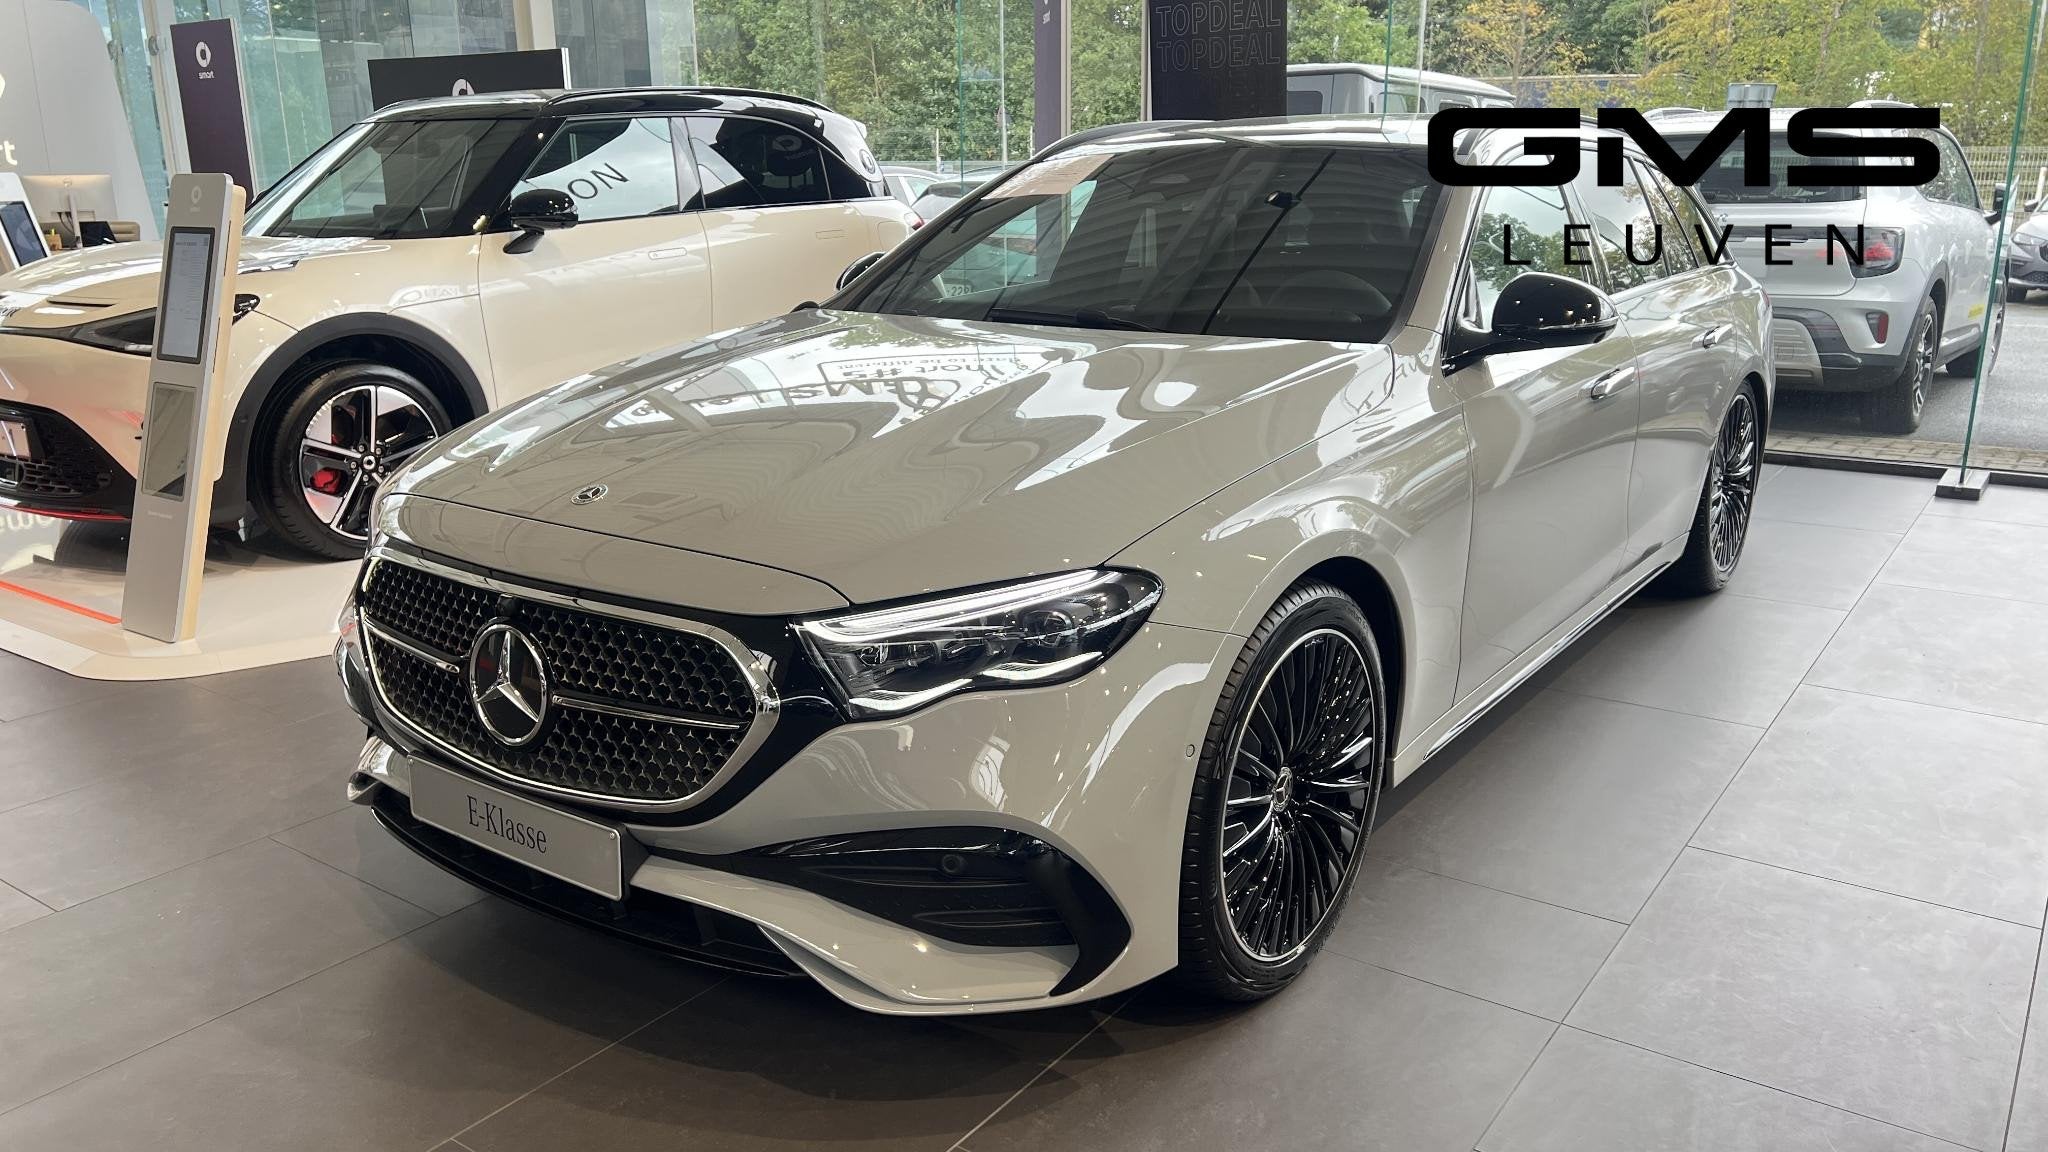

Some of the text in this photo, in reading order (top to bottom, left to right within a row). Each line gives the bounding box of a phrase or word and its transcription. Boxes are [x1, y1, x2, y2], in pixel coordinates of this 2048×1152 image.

[1155, 0, 1281, 37] TOPDEAL
[1156, 32, 1281, 72] TOPDEAL
[467, 795, 547, 854] E-Klasse
